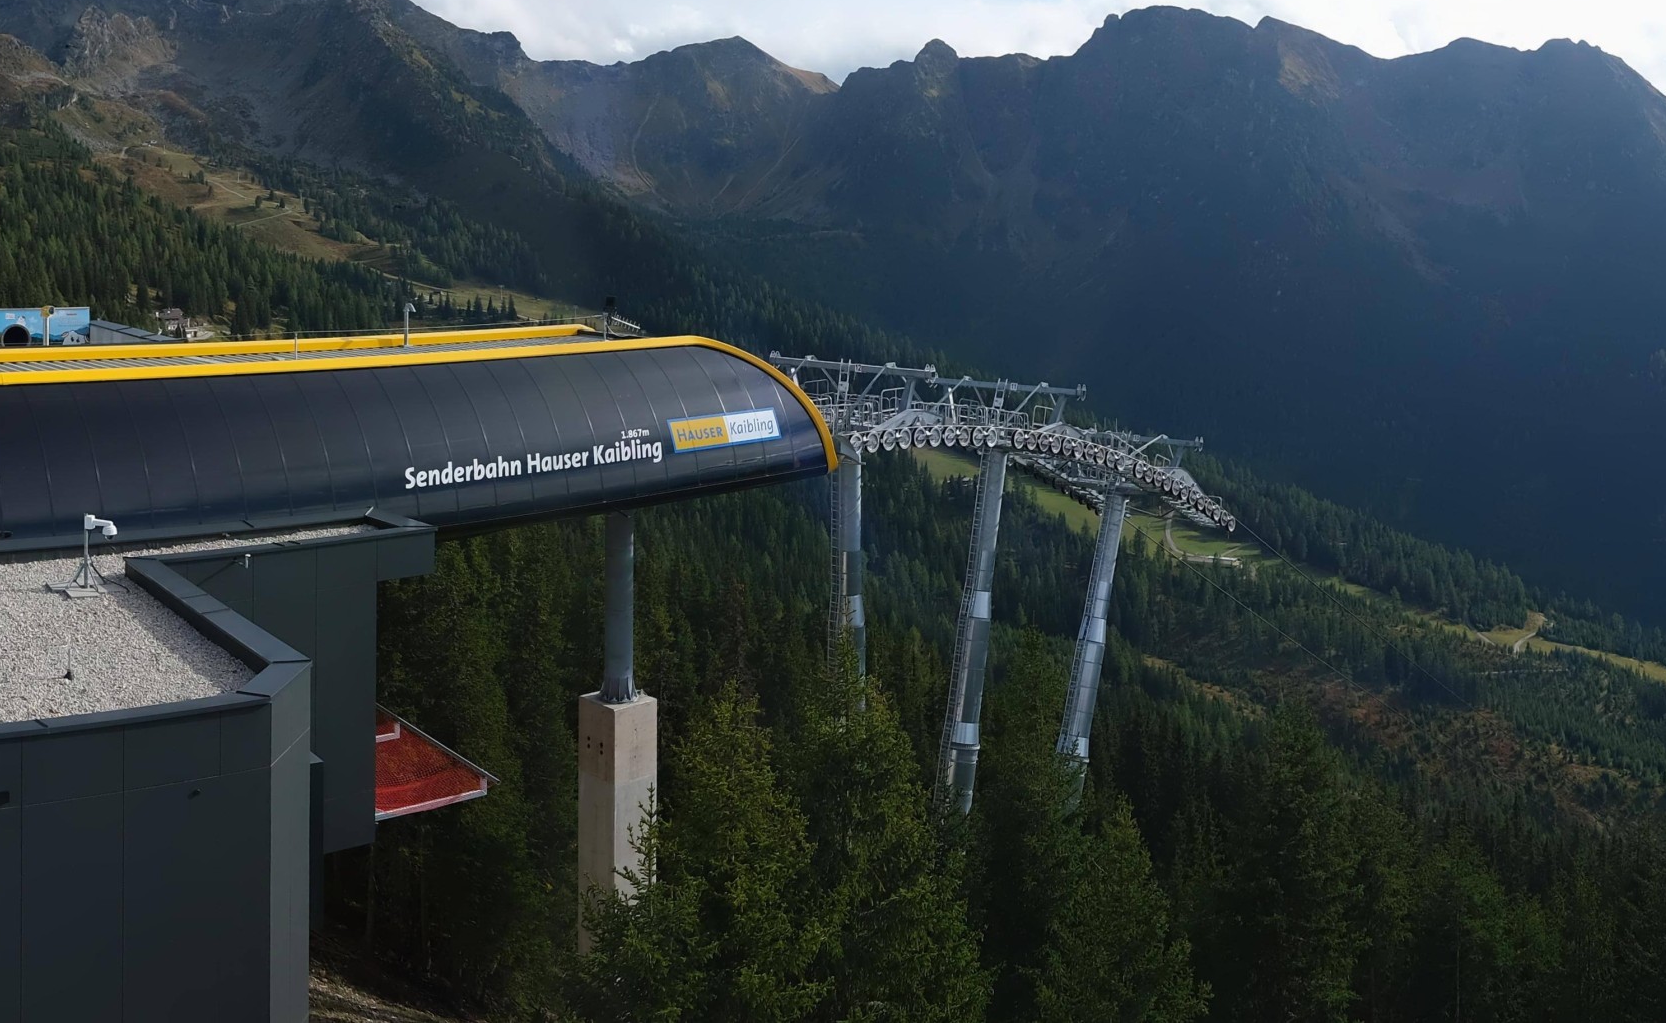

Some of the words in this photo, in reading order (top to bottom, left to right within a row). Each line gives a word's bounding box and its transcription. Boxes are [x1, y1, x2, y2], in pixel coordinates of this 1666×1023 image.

[620, 428, 650, 440] 1.867m
[677, 426, 723, 443] HAUSER
[729, 419, 774, 436] Kaibling
[404, 456, 522, 490] Senderbahn
[526, 450, 589, 474] Hauser
[592, 439, 663, 465] Kaibling
